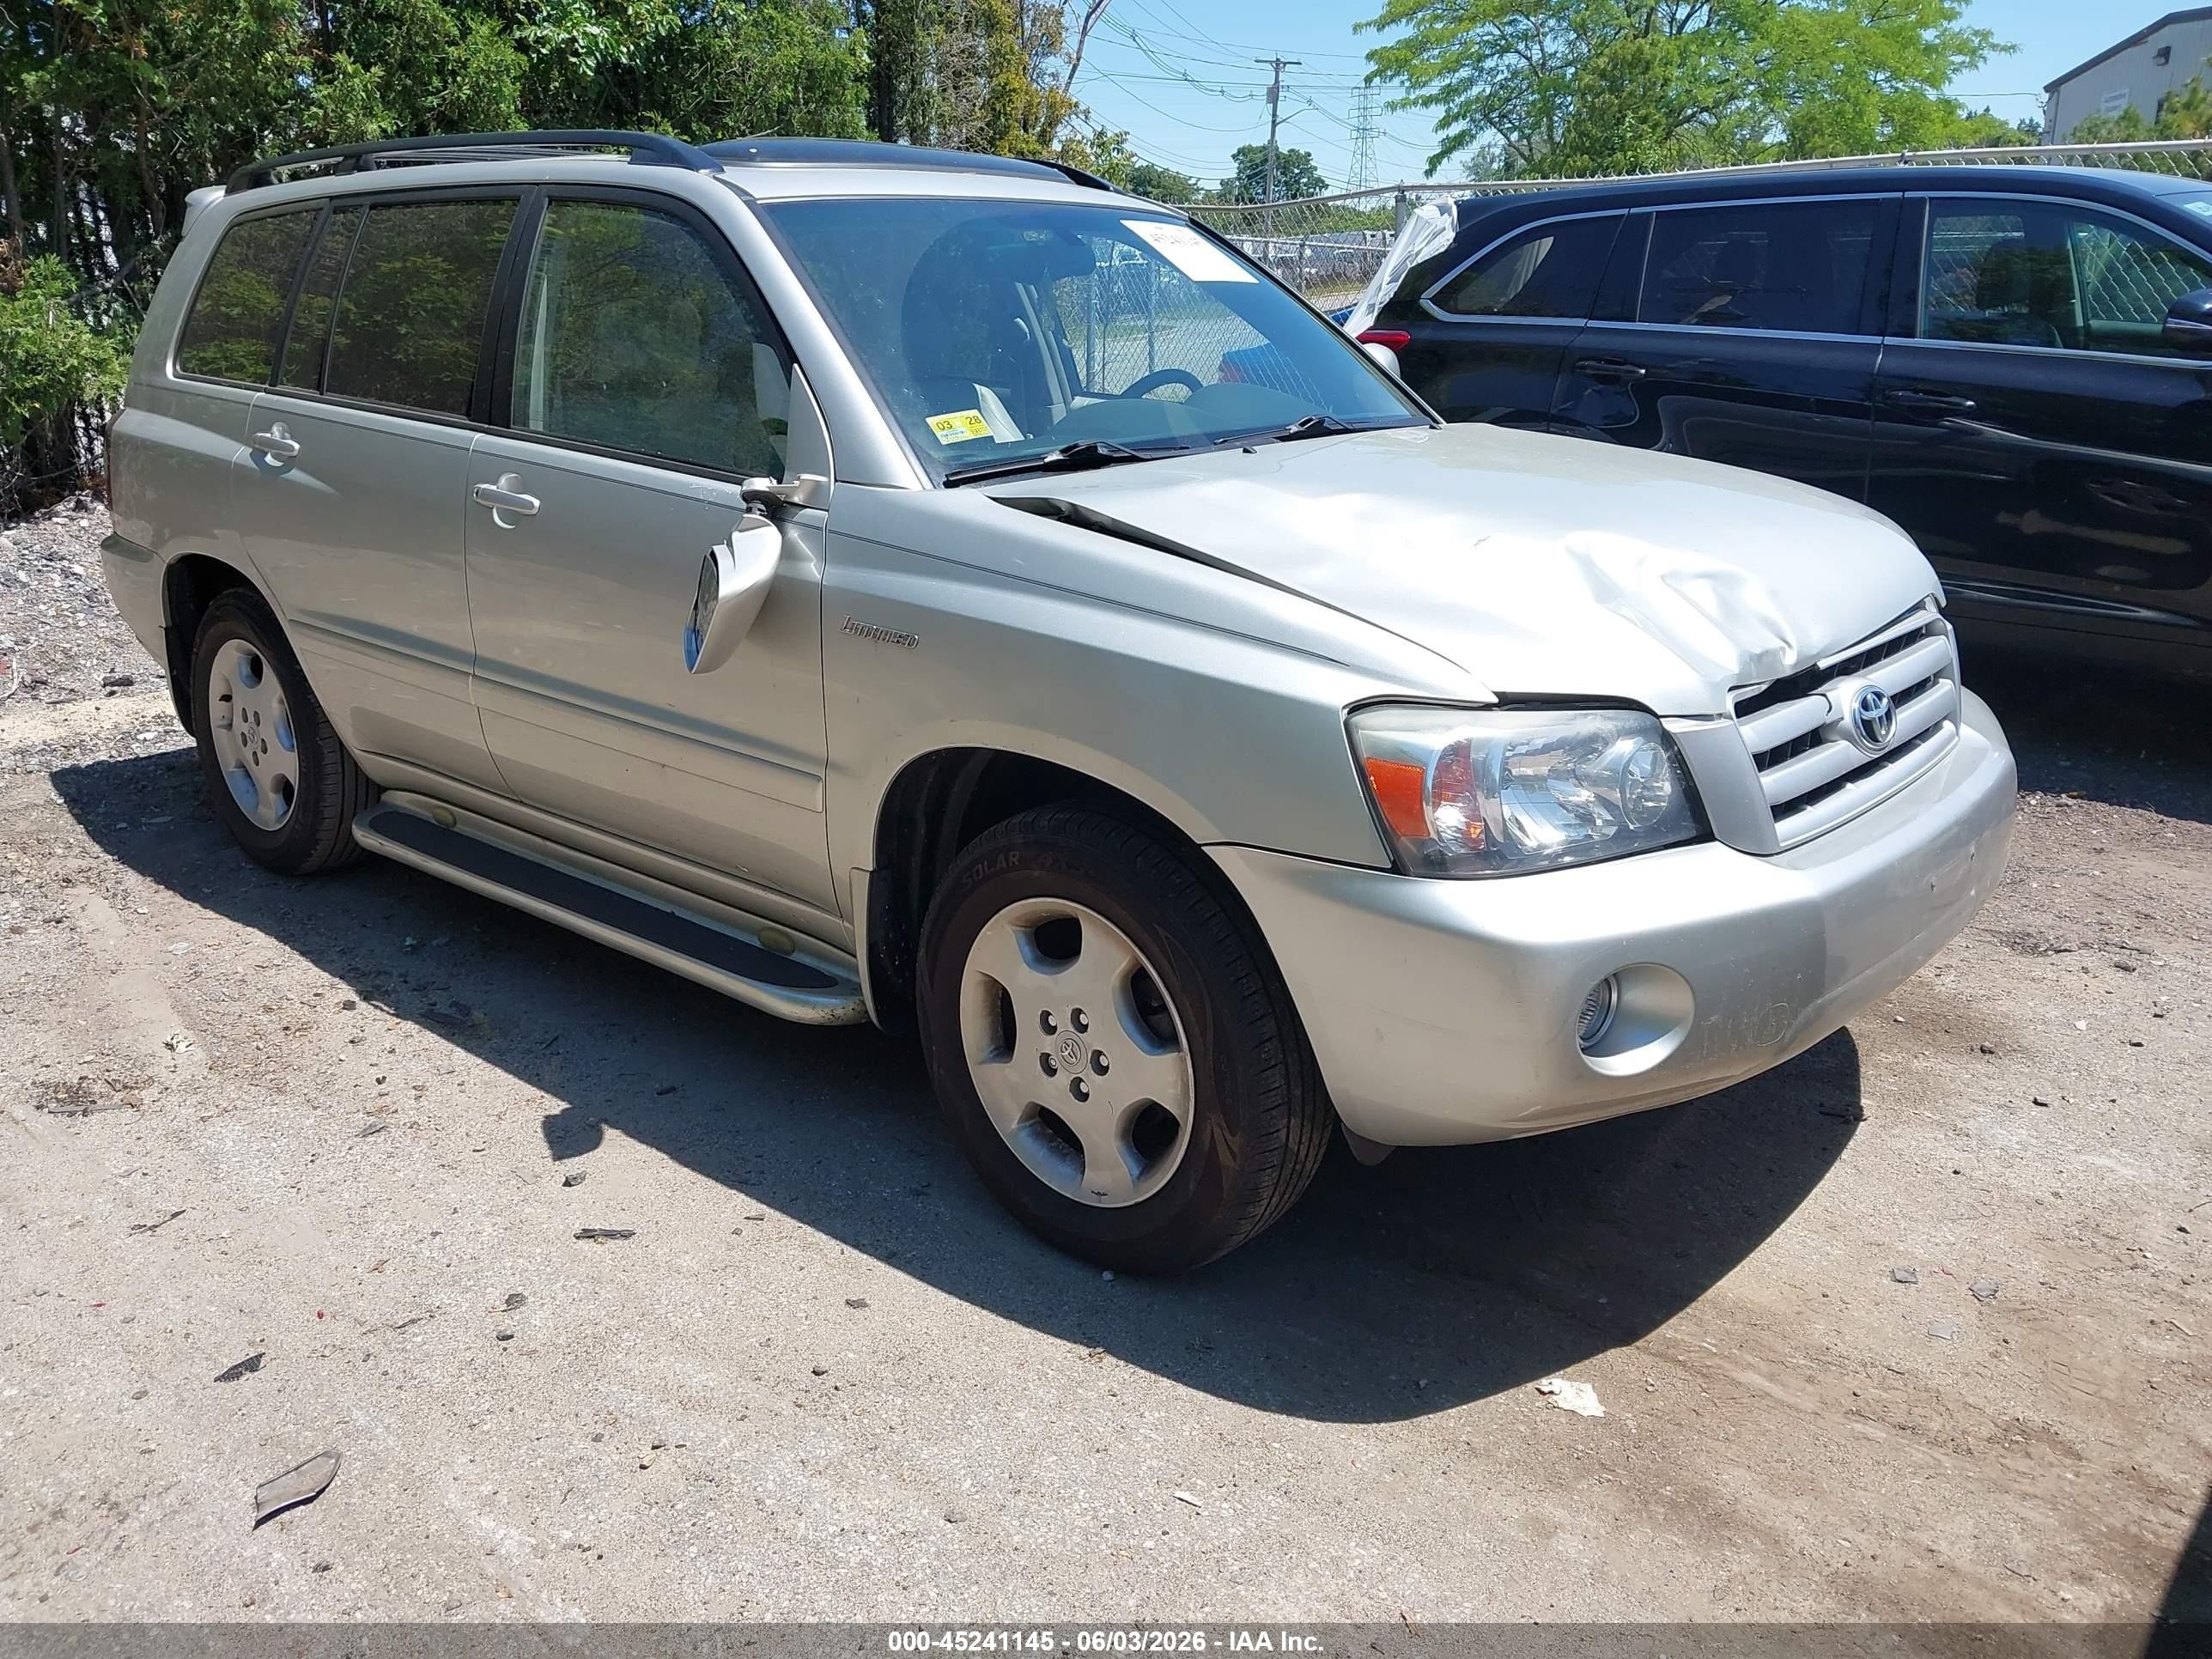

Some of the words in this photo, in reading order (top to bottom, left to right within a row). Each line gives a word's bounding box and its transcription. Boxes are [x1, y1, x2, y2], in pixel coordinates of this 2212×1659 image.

[935, 420, 953, 431] 03
[965, 415, 982, 426] 28
[961, 851, 1020, 889] SOLAR
